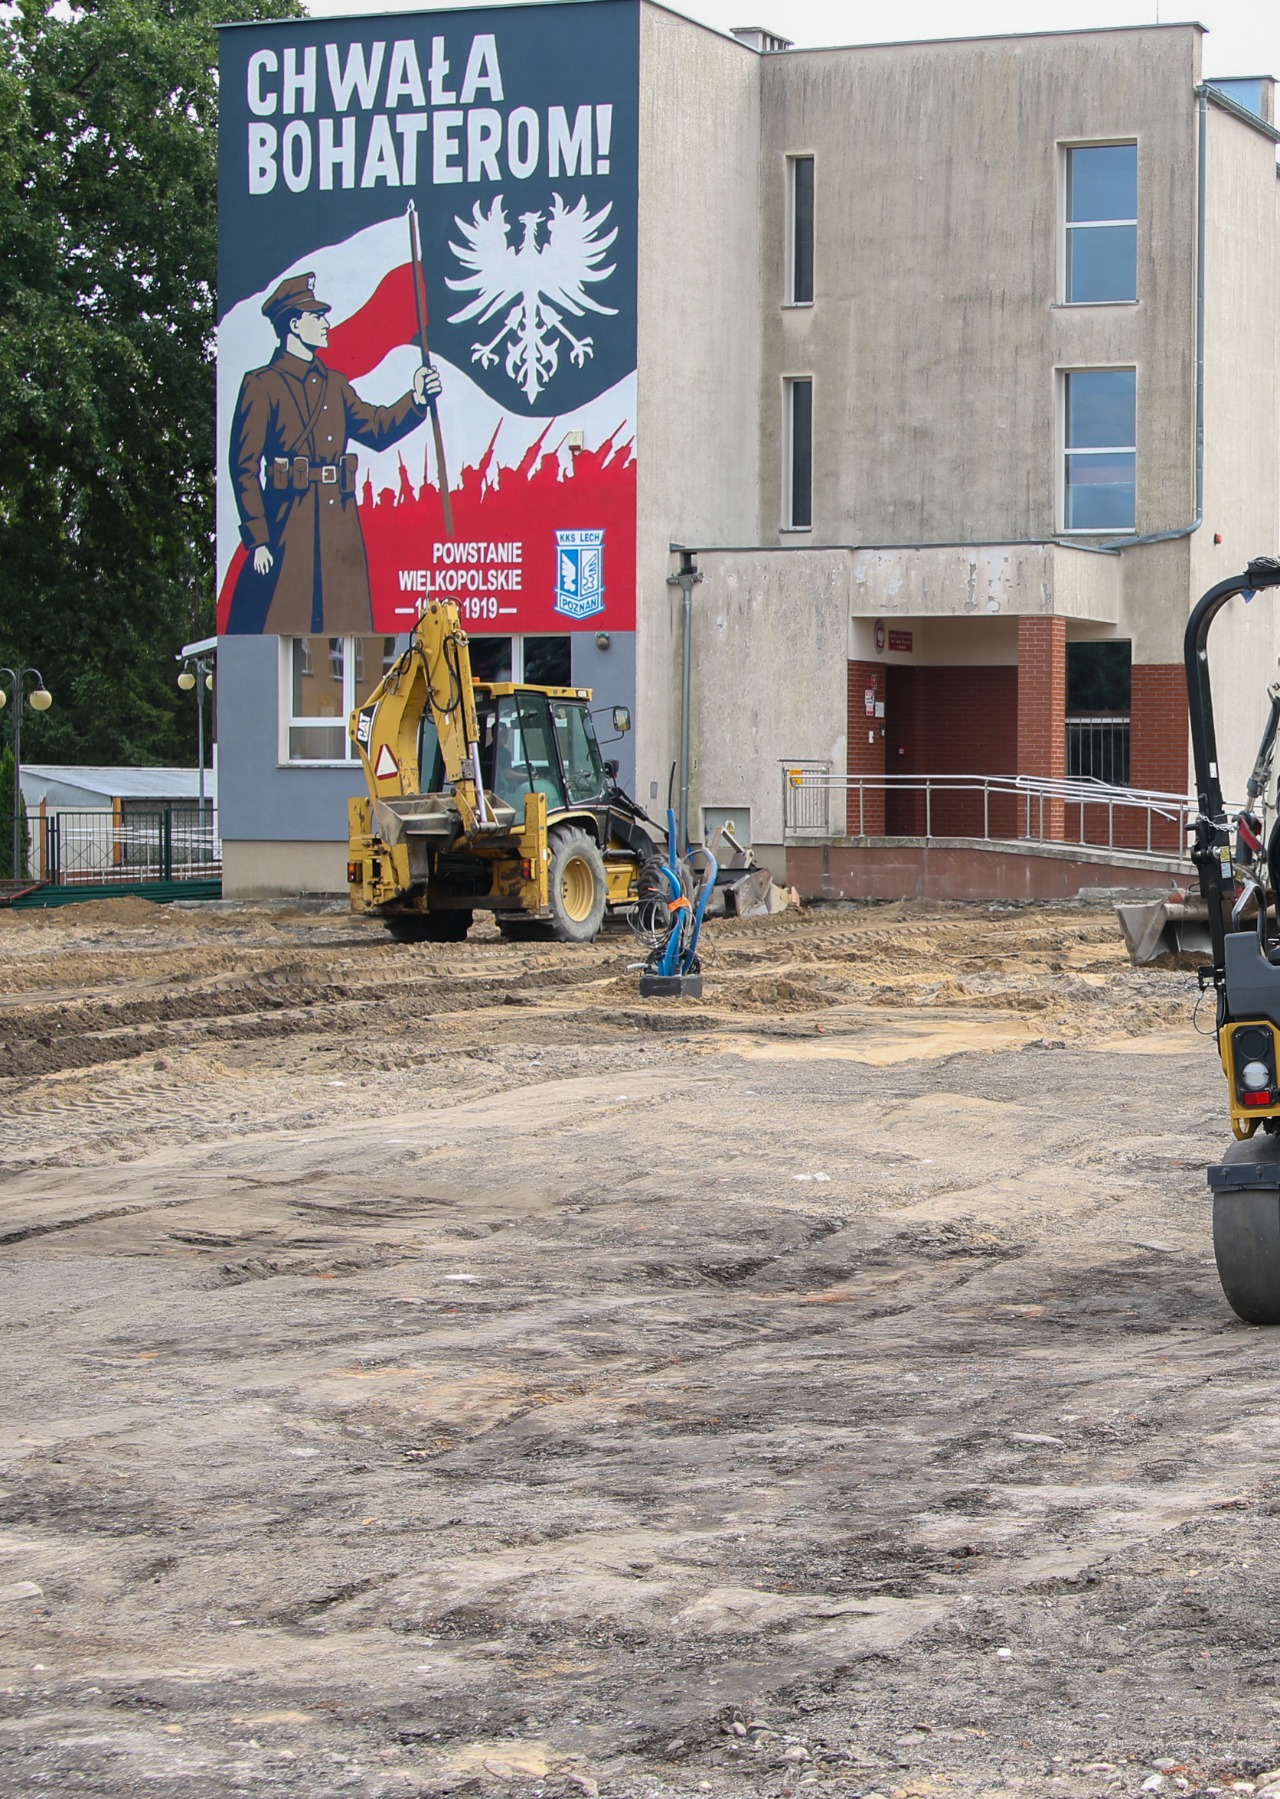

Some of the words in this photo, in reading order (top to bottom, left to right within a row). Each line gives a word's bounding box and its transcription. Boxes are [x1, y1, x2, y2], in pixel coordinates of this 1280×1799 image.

[247, 34, 504, 116] CHWAŁA
[248, 104, 613, 194] BOHATEROM!
[560, 533, 576, 543] KKS
[580, 532, 600, 543] LECH
[432, 541, 523, 564] POWSTANIE
[398, 569, 522, 592] WIELKOPOLSKIE
[357, 711, 371, 742] CAT
